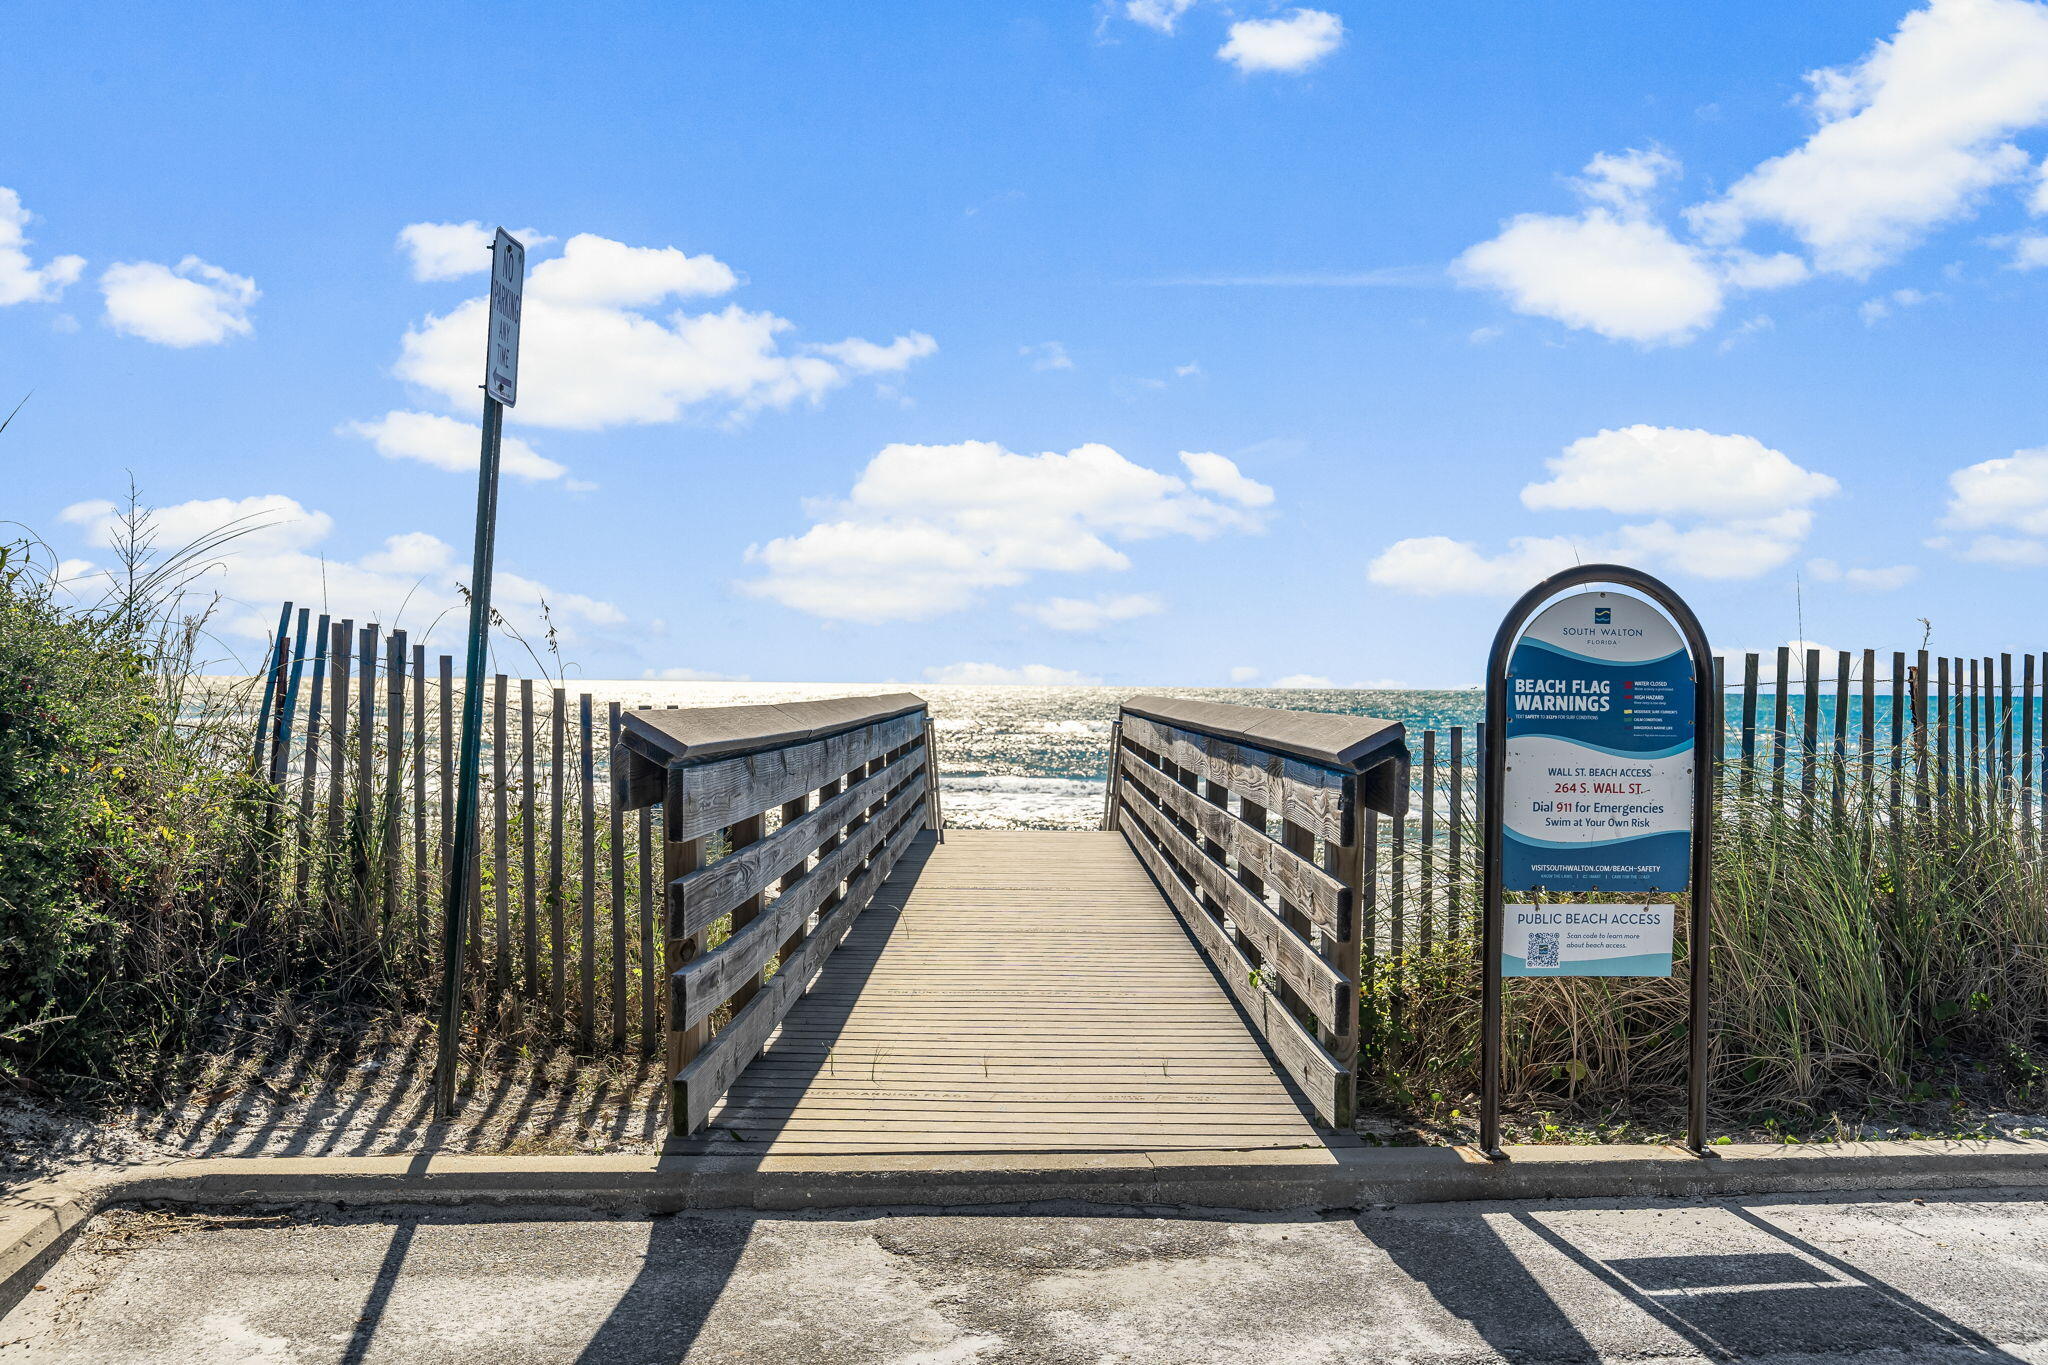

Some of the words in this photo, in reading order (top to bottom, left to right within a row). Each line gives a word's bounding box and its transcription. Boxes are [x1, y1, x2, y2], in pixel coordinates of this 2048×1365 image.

[502, 249, 514, 283] NO
[493, 280, 520, 324] PARKING
[498, 319, 511, 343] ANY
[497, 343, 510, 369] TIME
[1562, 627, 1596, 636] SOUTH
[1600, 628, 1643, 637] WALTON
[1515, 679, 1566, 693] BEACH
[1572, 680, 1610, 694] FLAG
[1514, 695, 1611, 712] WARNINGS
[1548, 768, 1572, 776] WALL
[1575, 768, 1587, 776] ST.
[1589, 768, 1617, 776] BEACH
[1620, 768, 1652, 778] ACCESS
[1554, 783, 1577, 793] 264
[1580, 783, 1590, 793] S.
[1593, 783, 1625, 794] WALL
[1629, 783, 1643, 794] ST.
[1532, 801, 1553, 812] Dial
[1556, 802, 1572, 812] 911
[1575, 801, 1591, 813] for
[1594, 802, 1664, 817] Emergencies
[1545, 817, 1571, 827] Swim
[1573, 819, 1583, 827] at
[1585, 818, 1605, 827] Your
[1608, 818, 1629, 827] Own
[1631, 818, 1650, 828] Risk
[1531, 864, 1661, 873] VISITSOUTHWALTON.COM/BEACH-SAFETY
[1518, 913, 1562, 924] PUBLIC
[1565, 913, 1608, 925] BEACH
[1611, 913, 1661, 925] ACCESS
[1566, 932, 1582, 940] Scan
[1583, 932, 1598, 940] code
[1599, 932, 1606, 940] to
[1607, 932, 1623, 940] learn
[1566, 941, 1584, 949] about
[1586, 941, 1604, 949] beach
